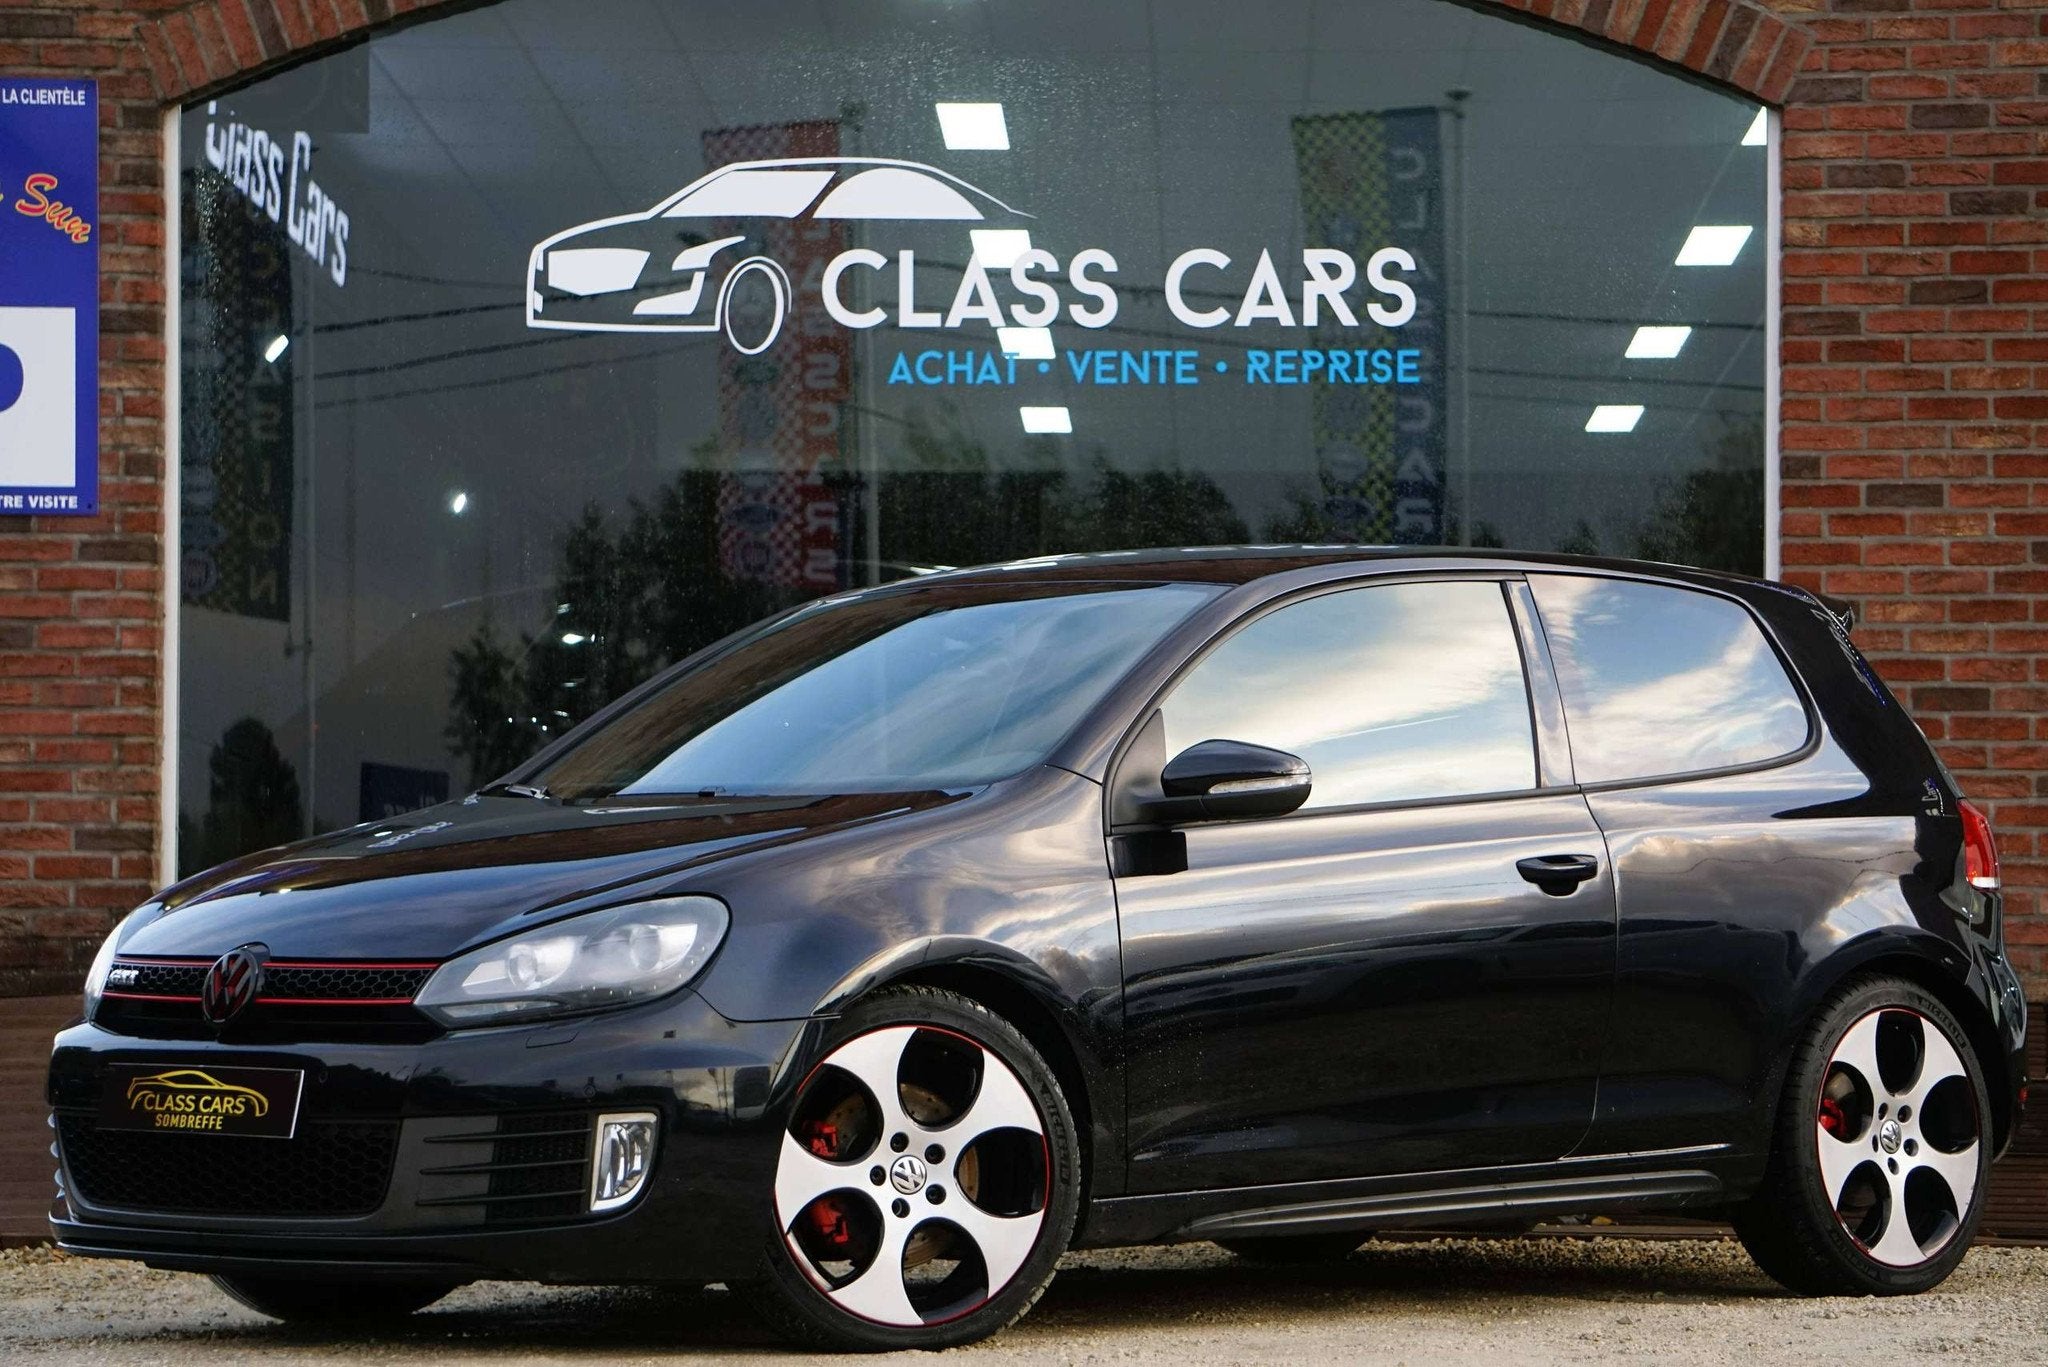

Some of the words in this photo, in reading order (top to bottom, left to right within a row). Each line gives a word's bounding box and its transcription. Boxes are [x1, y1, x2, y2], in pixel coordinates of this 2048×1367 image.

[2, 88, 18, 104] LA
[20, 87, 86, 106] CLIENTÈLE
[15, 173, 91, 243] Sun
[287, 131, 349, 287] Cars
[821, 248, 1119, 329] CLASS
[1164, 247, 1417, 328] CARS
[887, 350, 1020, 385] ACHAT
[1066, 350, 1199, 385] VENTE
[1246, 349, 1421, 384] REPRISE
[28, 495, 78, 509] VISITE
[109, 969, 139, 986] GTI
[143, 1094, 195, 1112] CLASS
[200, 1097, 246, 1115] CARS
[155, 1113, 224, 1130] SOMBREFFE
